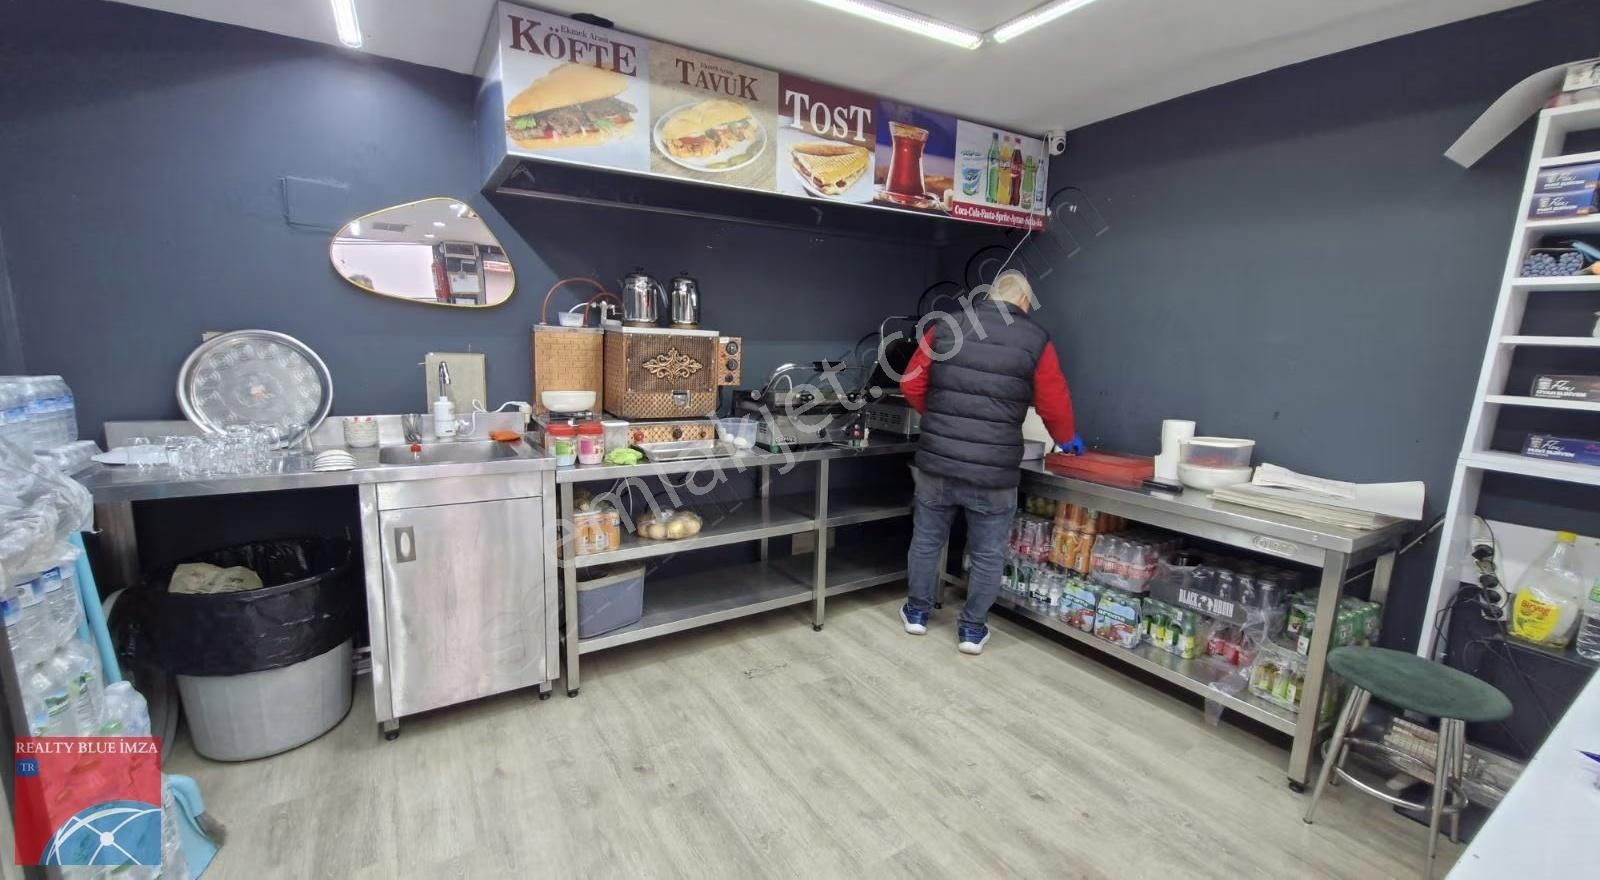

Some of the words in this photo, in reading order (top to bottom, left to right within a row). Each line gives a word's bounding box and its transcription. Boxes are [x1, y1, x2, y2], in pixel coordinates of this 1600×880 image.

[507, 14, 637, 77] KÖFTE
[675, 58, 759, 102] TAVUK
[785, 89, 871, 142] TOST
[1178, 588, 1199, 607] BLACK
